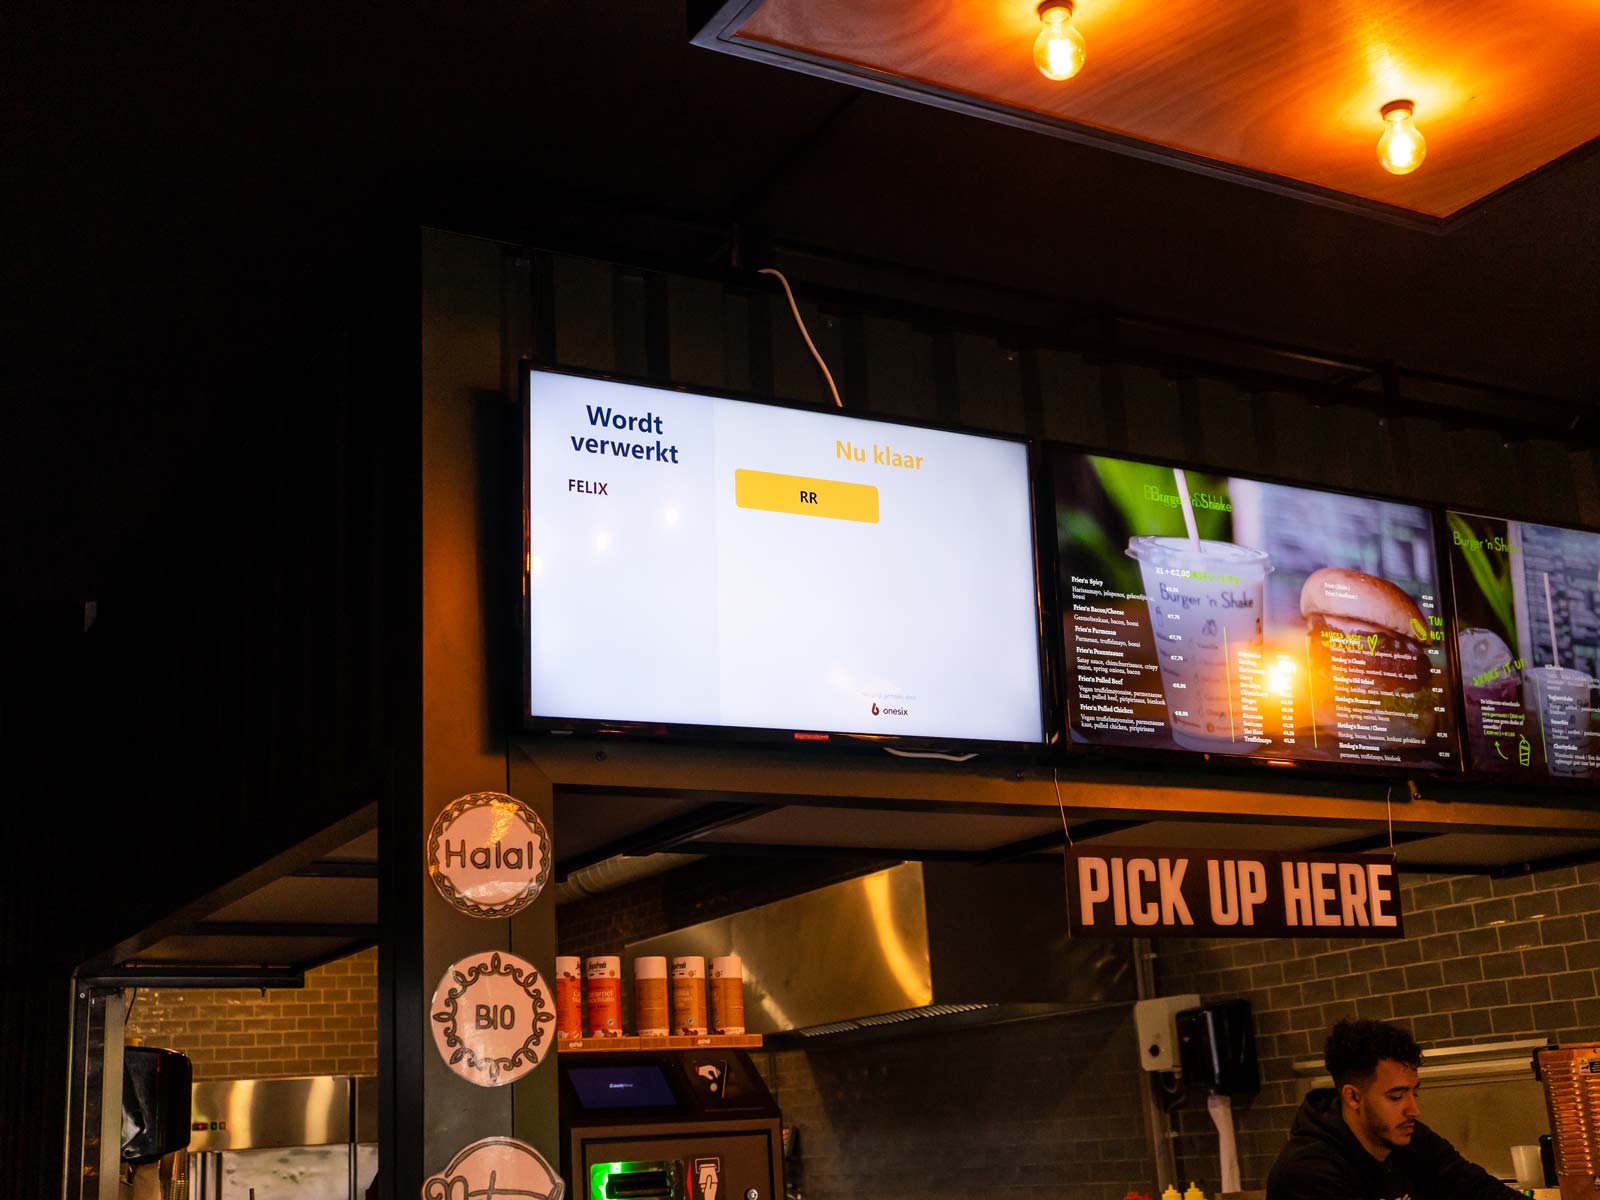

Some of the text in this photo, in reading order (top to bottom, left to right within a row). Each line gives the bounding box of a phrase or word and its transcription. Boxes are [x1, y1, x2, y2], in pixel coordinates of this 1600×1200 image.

[586, 404, 664, 435] Wordt
[570, 434, 679, 464] verwerkt
[836, 440, 924, 470] Nu klaar
[568, 479, 608, 496] FELIX
[800, 490, 818, 505] RR
[1453, 531, 1483, 551] Burger
[1090, 579, 1103, 587] Spicy
[1221, 591, 1254, 608] Shake
[883, 707, 908, 716] onesix
[1114, 706, 1134, 714] Chicken
[446, 839, 533, 869] Halal
[1078, 857, 1397, 926] PICK UP HERE
[475, 1004, 515, 1030] BIO
